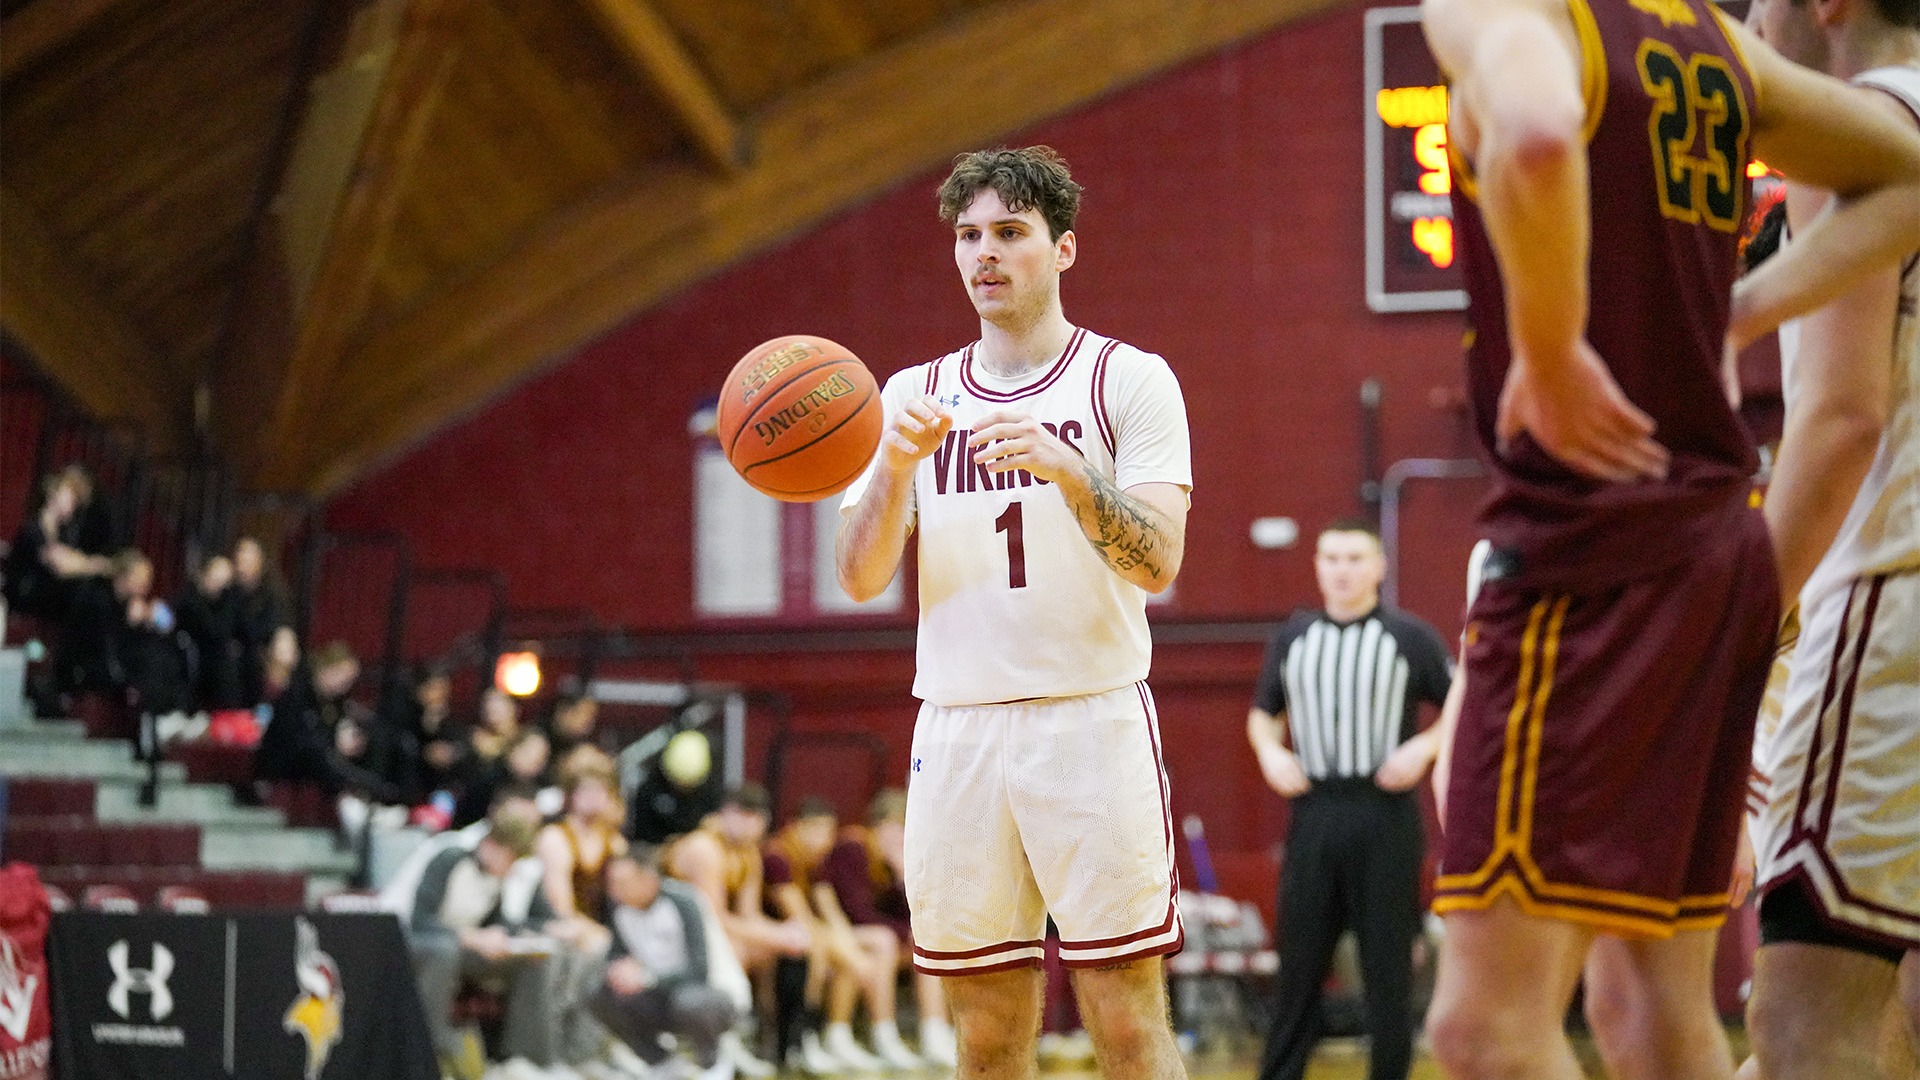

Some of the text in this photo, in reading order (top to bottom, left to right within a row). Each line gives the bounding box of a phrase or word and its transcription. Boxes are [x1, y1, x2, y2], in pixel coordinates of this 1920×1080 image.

[1635, 38, 1750, 233] 23
[754, 369, 856, 447] SPALDING
[995, 501, 1027, 589] 1
